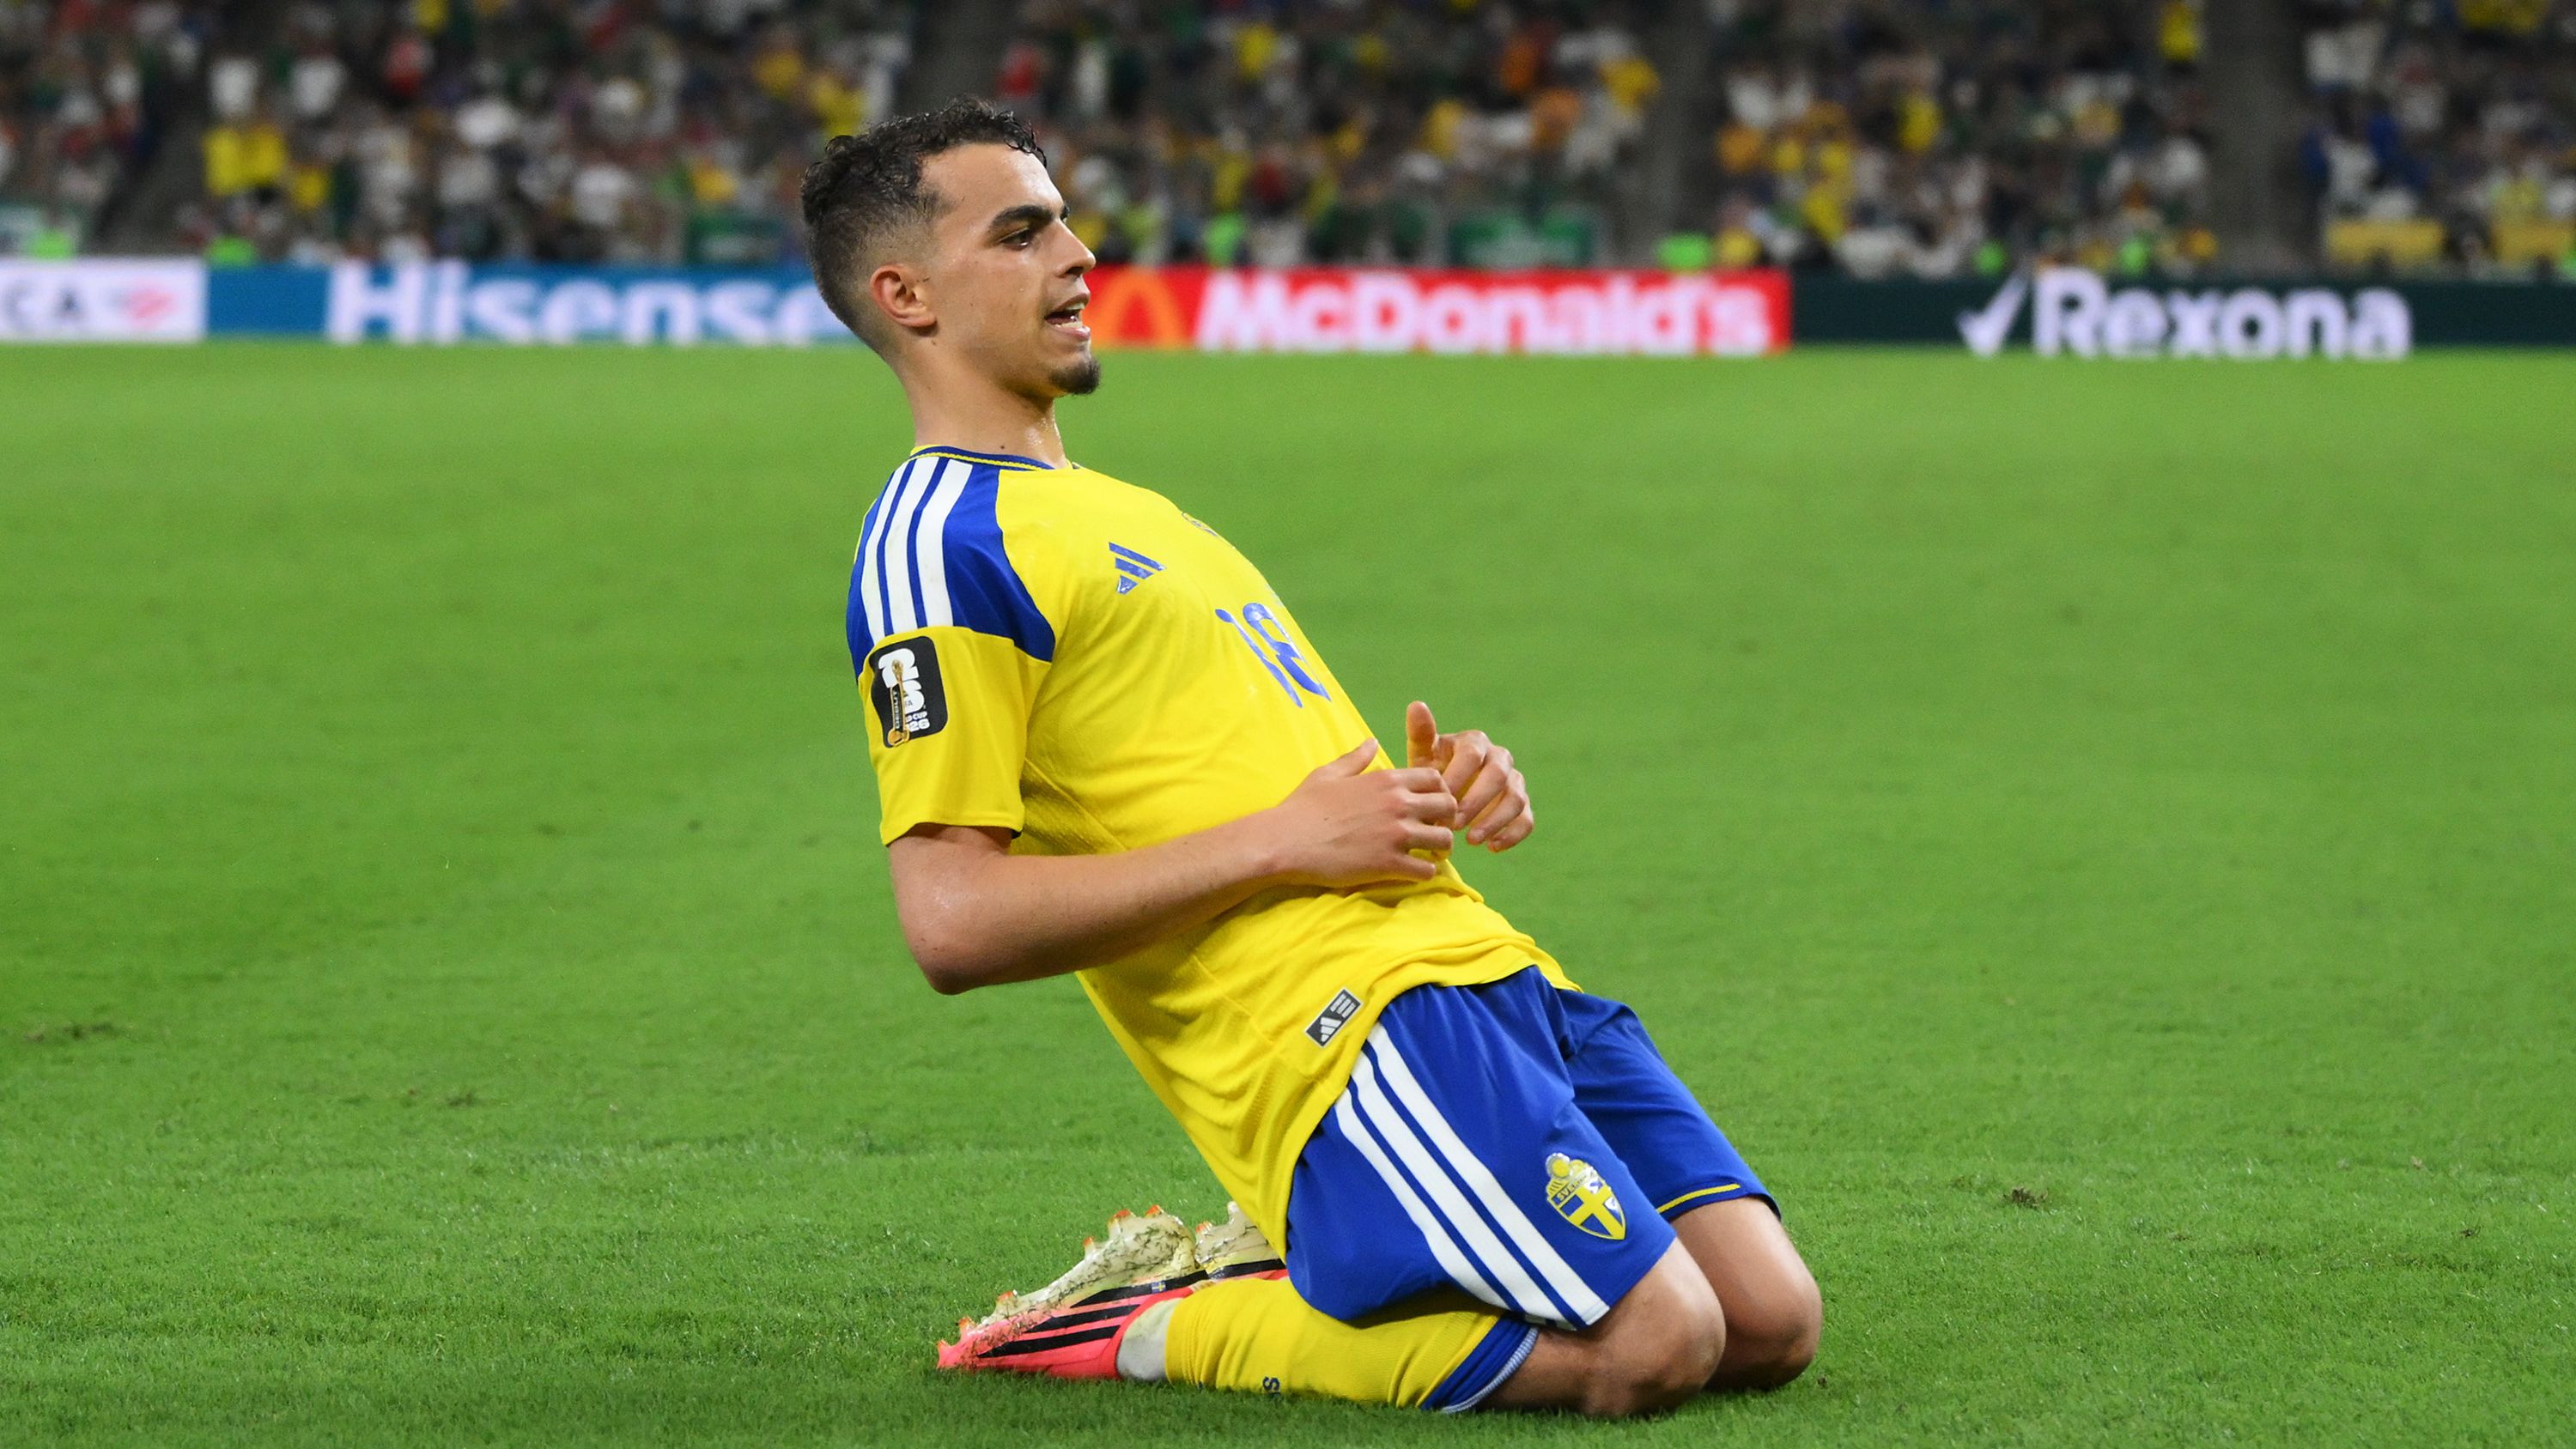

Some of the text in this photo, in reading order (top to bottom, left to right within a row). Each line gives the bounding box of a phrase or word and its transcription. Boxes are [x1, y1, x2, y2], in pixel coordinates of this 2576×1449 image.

[328, 260, 852, 344] Hisense
[1199, 273, 1772, 354] McDonald's
[2034, 268, 2411, 359] Rexona
[1214, 603, 1331, 707] 18
